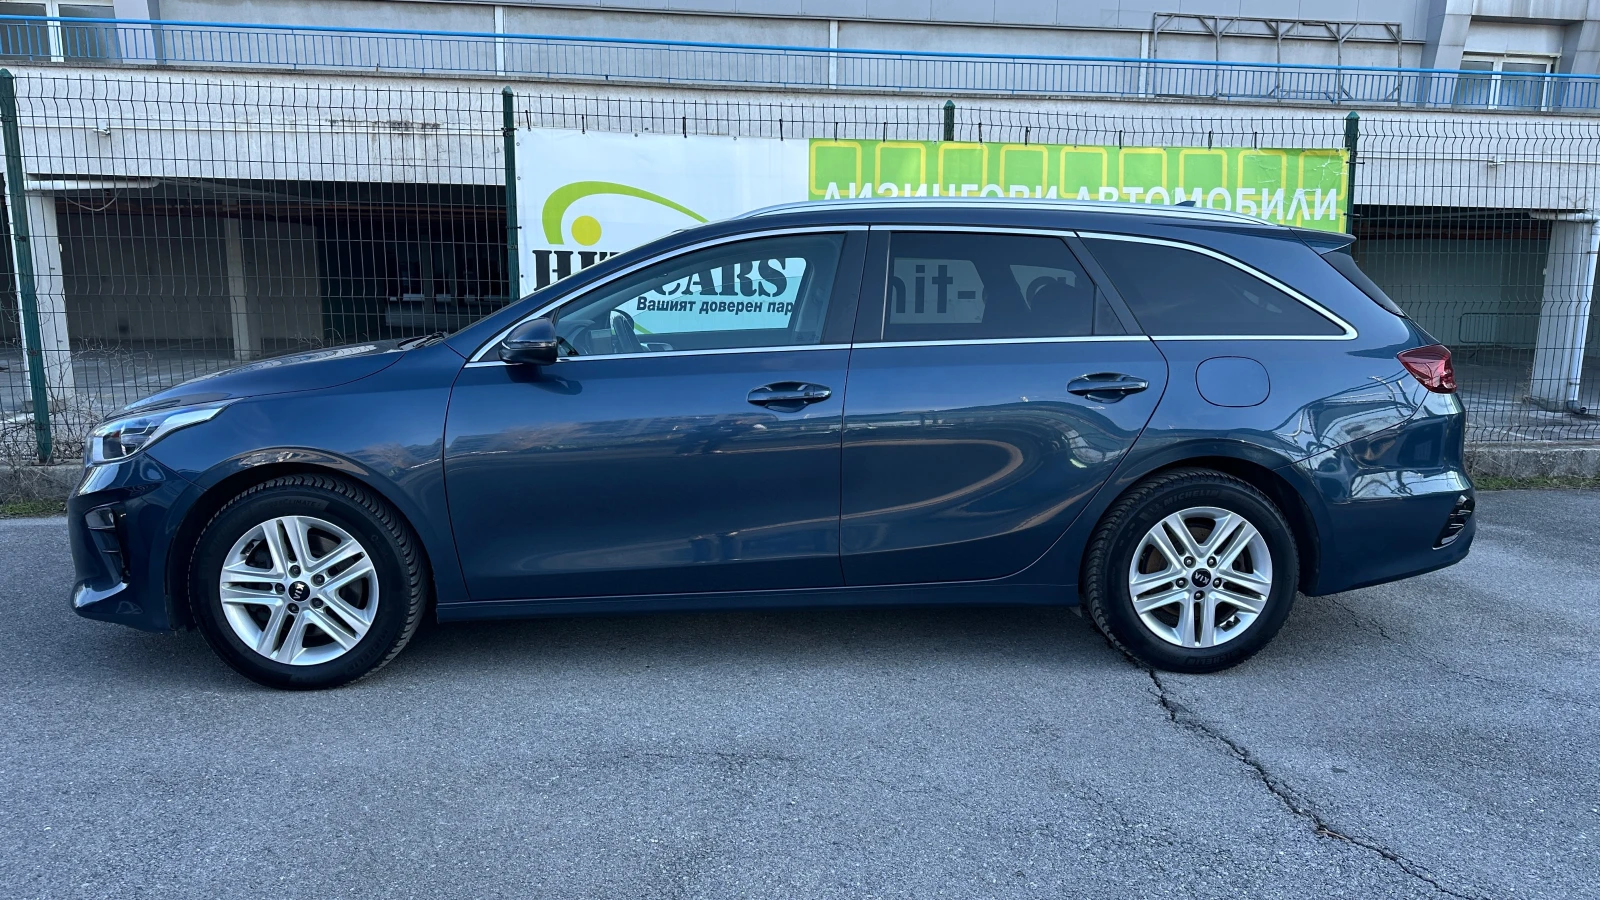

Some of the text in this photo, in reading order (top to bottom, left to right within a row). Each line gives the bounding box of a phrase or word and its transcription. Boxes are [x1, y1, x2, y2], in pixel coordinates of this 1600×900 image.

[636, 296, 696, 312] Вашият
[699, 301, 763, 315] доверен
[1163, 488, 1220, 506] MICHELIN
[1195, 572, 1209, 584] KIA
[293, 583, 304, 598] KIA
